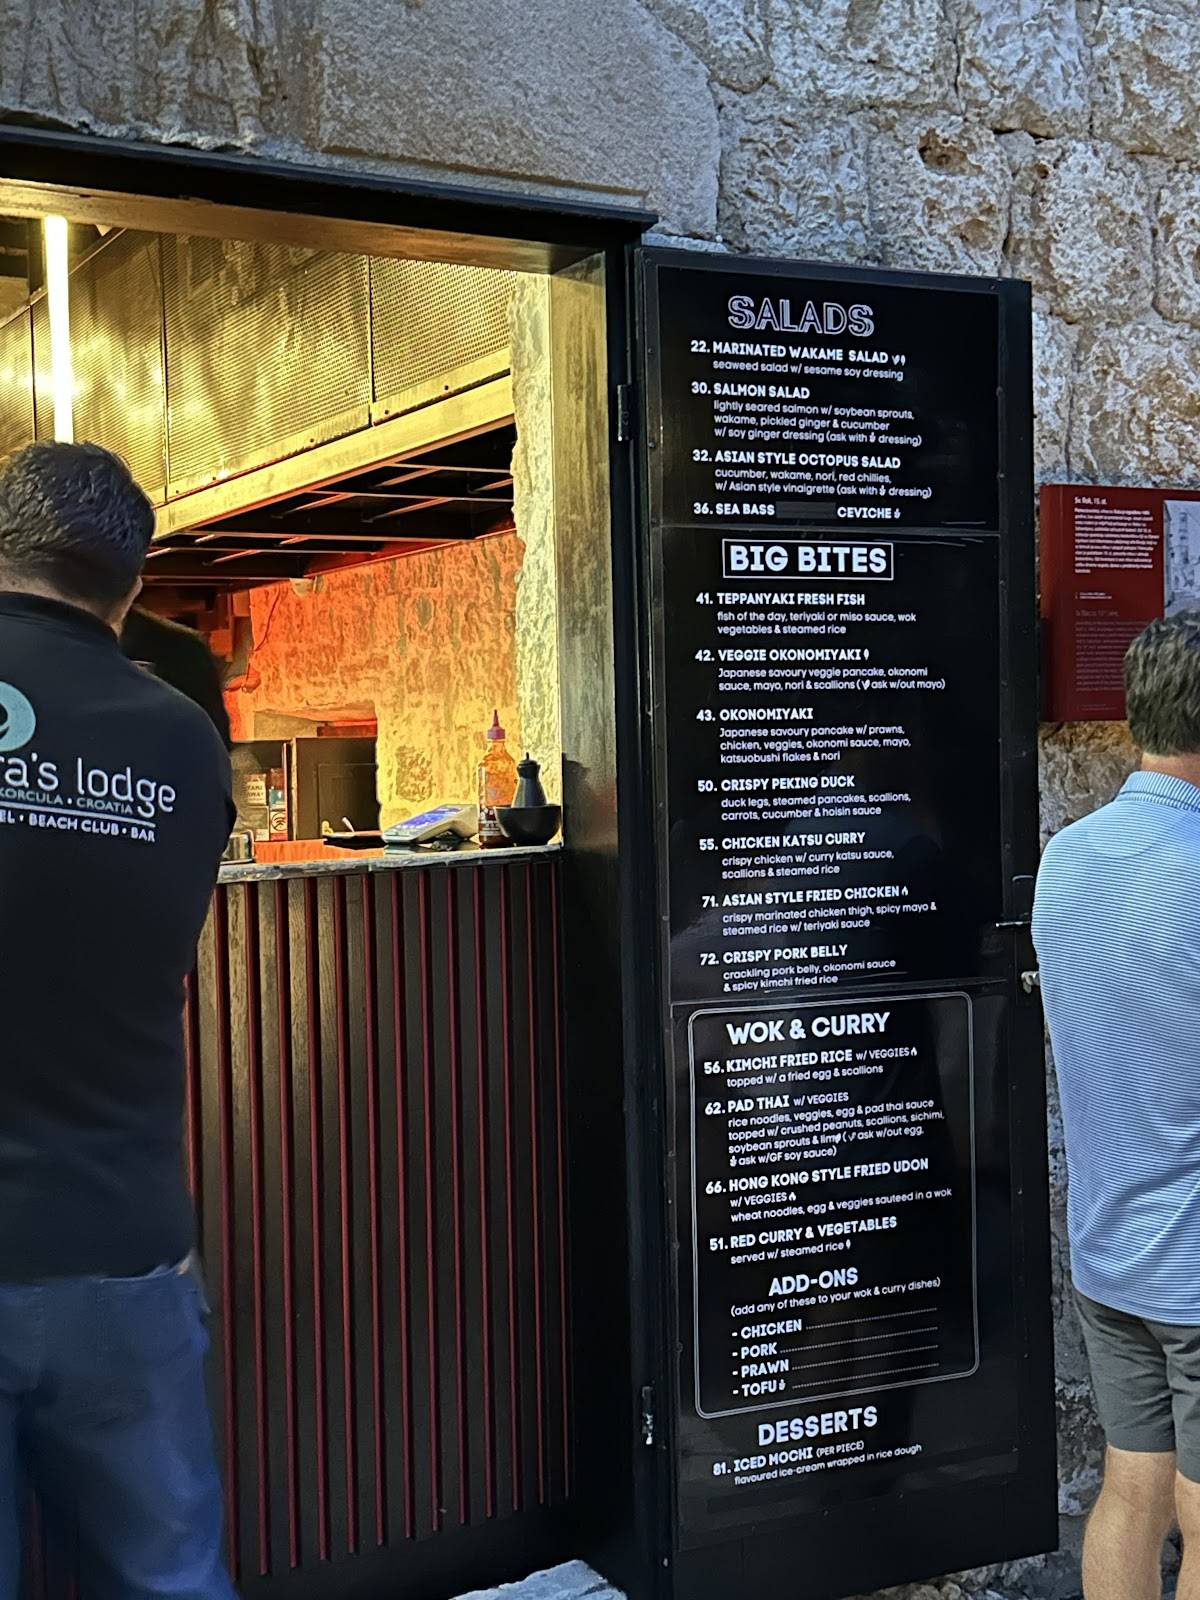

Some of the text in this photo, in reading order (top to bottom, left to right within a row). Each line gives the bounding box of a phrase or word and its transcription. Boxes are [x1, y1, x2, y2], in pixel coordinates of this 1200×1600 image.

[728, 295, 875, 337] SALADS
[691, 340, 889, 363] 22. MARINATED WAKAME SALAD
[713, 360, 904, 381] seaweed salad w/ sesame soy dressing
[691, 382, 810, 399] 30. SALMON SALAD
[692, 449, 901, 469] 32. ASIAN STYLE OCTOPUS SALAD
[693, 502, 892, 519] 36. SEA BASS CEVICHE
[730, 545, 887, 573] BIG BITES
[696, 592, 865, 605] 41. TEPPANYAKI FRESH FISH
[717, 611, 735, 621] fish
[736, 611, 748, 621] of
[749, 611, 766, 621] the
[789, 611, 825, 623] teriyaki
[827, 613, 838, 621] or
[840, 611, 863, 622] miso
[897, 613, 916, 622] wok
[695, 649, 861, 661] 42. VEGGIE OKONOMIYAKI
[718, 668, 767, 679] Japanese
[768, 669, 807, 679] savoury
[808, 667, 841, 679] veggie
[887, 667, 928, 677] okonomi
[696, 707, 814, 721] 43. OKONOMIYAKI
[77, 757, 176, 818] lodge
[697, 775, 855, 792] 50. CRISPY PEKING DUCK
[76, 797, 133, 815] CROATIA
[721, 798, 746, 808] duck
[772, 795, 816, 806] steamed
[29, 812, 78, 831] BEACH
[81, 819, 119, 836] CLUB
[131, 826, 156, 843] BAR
[699, 832, 866, 851] 55. CHICKEN KATSU CURRY
[702, 885, 899, 908] 71. ASIAN STYLE FRIED CHICKEN
[700, 944, 848, 966] 72. CRISPY PORK BELLY
[726, 1012, 890, 1045] WOK & CURRY
[704, 1047, 910, 1074] 56. KIMCHI FRIED RICE w/ VEGGIES
[726, 1065, 884, 1087] topped w/ a fried egg & scallions
[705, 1092, 849, 1115] 62. PAD THAI w/ VEGGIES
[705, 1158, 929, 1194] 66. HONG KONG STYLE FRIED UDON
[730, 1191, 787, 1207] w/ VEGGIES
[710, 1216, 897, 1251] 51. RED CURRY & VEGETABLES
[730, 1242, 844, 1265] served w/ steamed rice
[768, 1267, 858, 1297] ADD-ONS
[730, 1276, 941, 1317] (add any of these to your wok & curry dishes)
[741, 1319, 802, 1339] CHICKEN
[741, 1342, 778, 1359] PORK
[741, 1359, 789, 1378] PRAWN
[741, 1379, 777, 1397] TOFU
[758, 1406, 878, 1446] DESSERTS
[713, 1440, 864, 1476] 81. ICED MOCHI (PER PIECE)
[734, 1444, 922, 1485] flavoured ice-cream wrapped in rice dough
